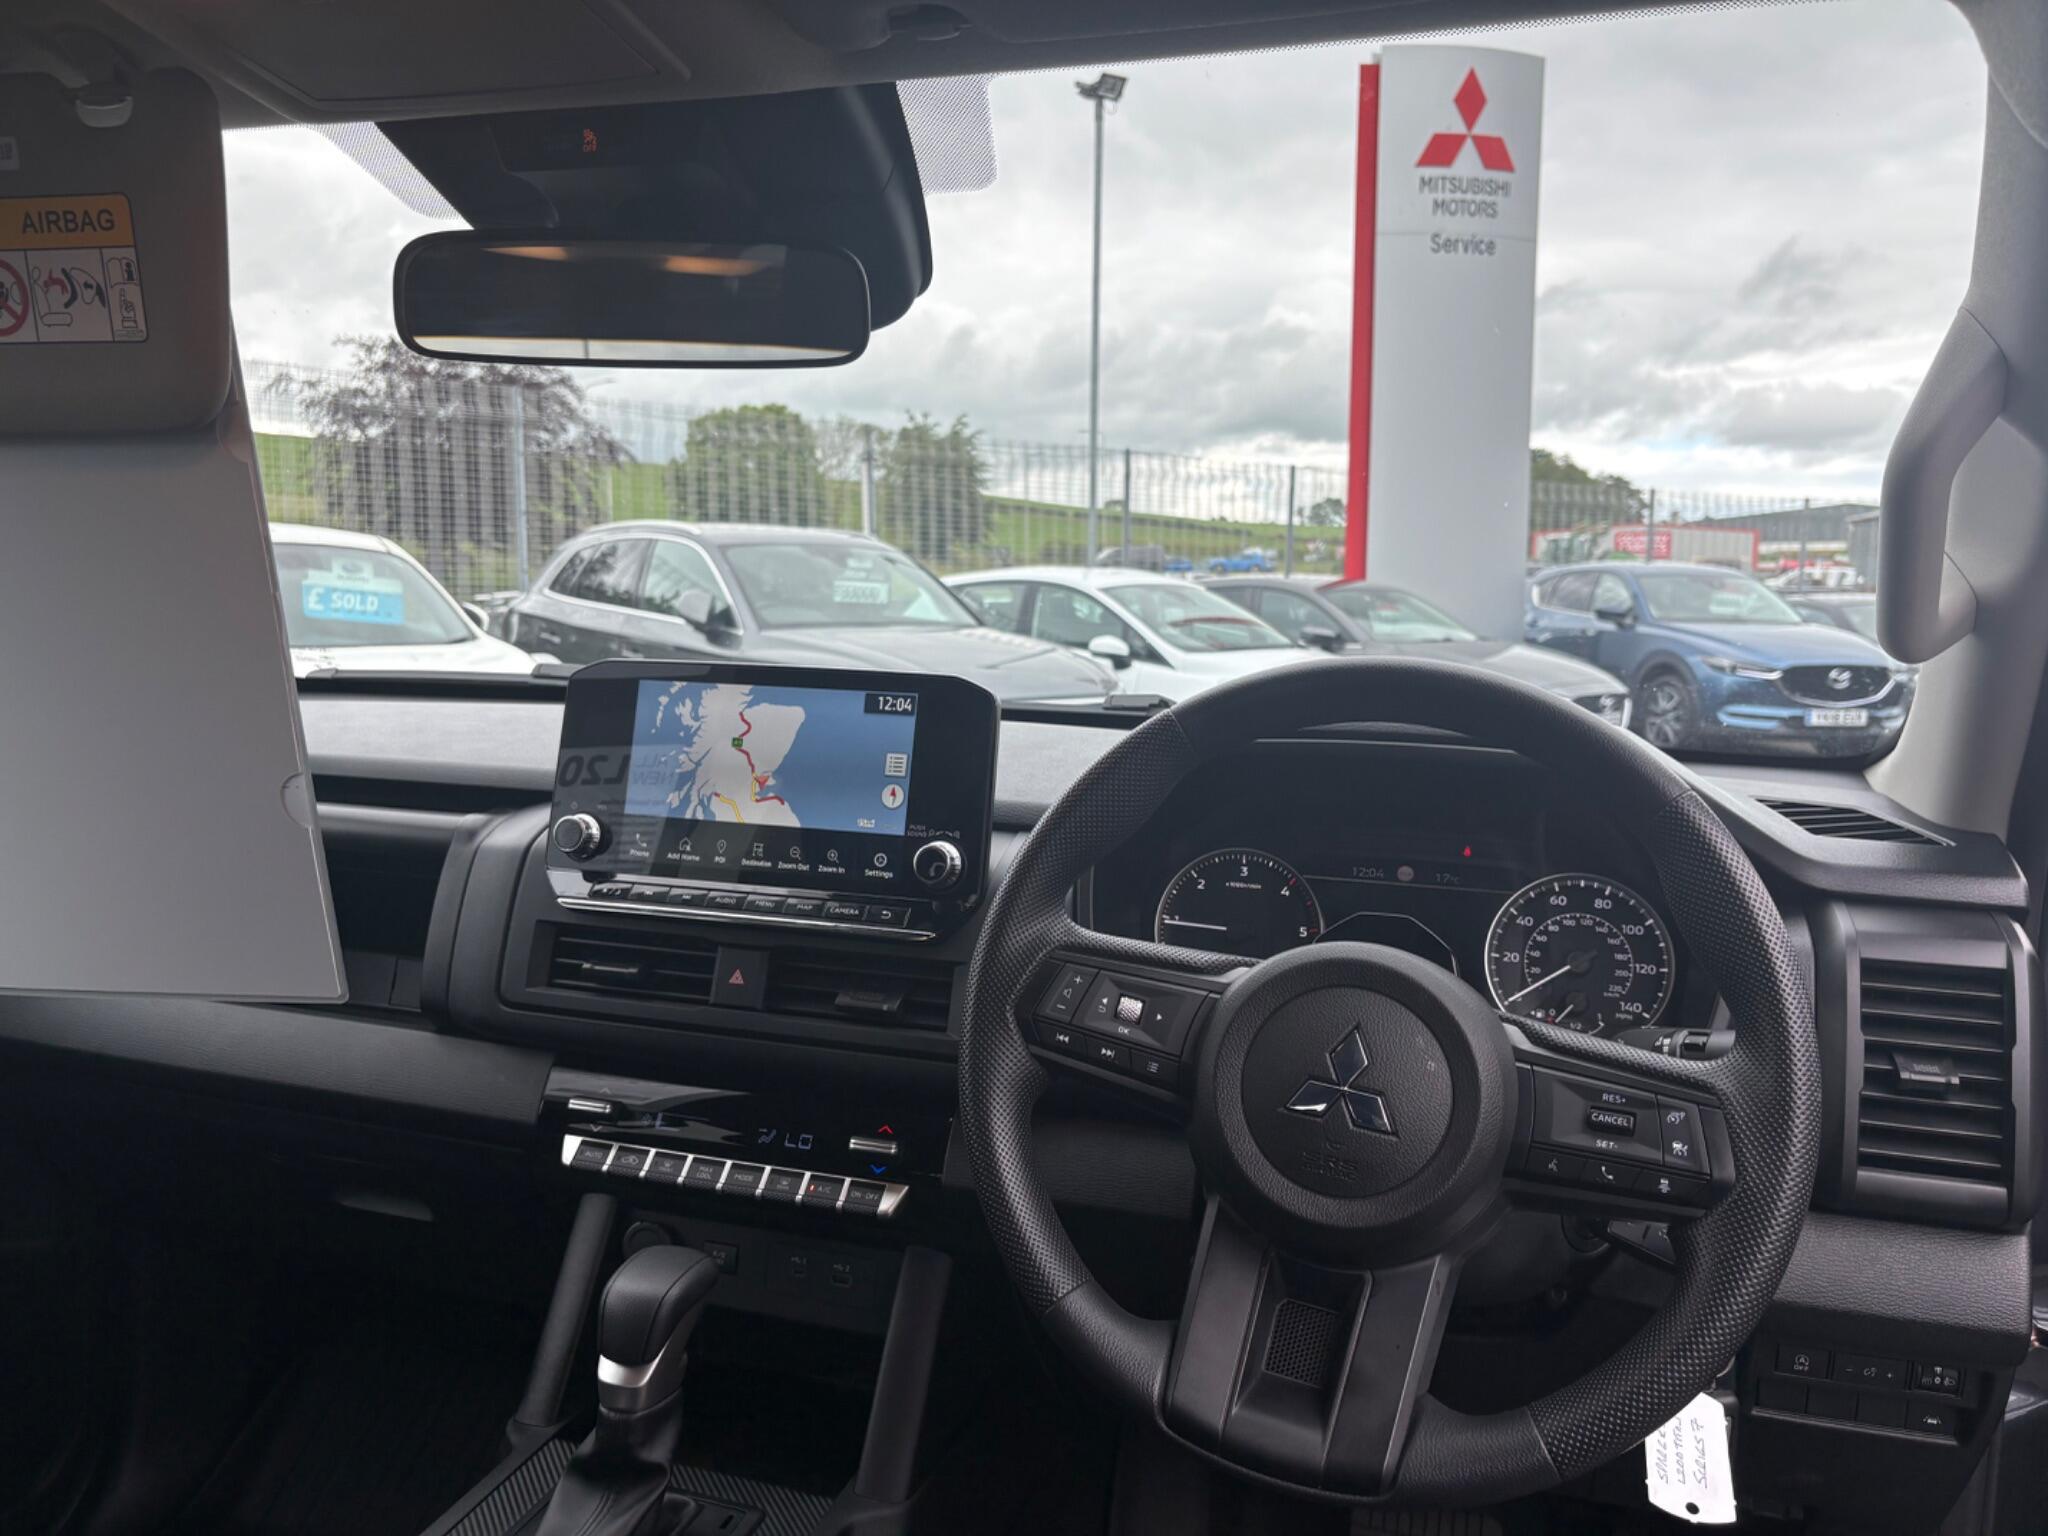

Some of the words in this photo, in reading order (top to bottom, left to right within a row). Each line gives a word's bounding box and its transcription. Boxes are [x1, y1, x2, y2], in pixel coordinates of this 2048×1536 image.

[1419, 176, 1511, 197] MITSUBISHI
[1432, 198, 1497, 218] MOTORS
[21, 208, 115, 235] AIRBAG
[1430, 233, 1496, 256] Service
[330, 592, 379, 612] SOLD
[877, 696, 913, 712] 12:04
[666, 852, 681, 860] Add
[682, 854, 700, 862] Home
[714, 856, 726, 864] POI
[778, 861, 797, 870] Zoom
[797, 863, 810, 871] Out
[818, 864, 836, 873] Zoom
[1239, 866, 1248, 877] 3
[864, 868, 893, 879] Settings
[1352, 866, 1384, 879] 12:04
[1196, 879, 1206, 890] 2
[1280, 886, 1290, 897] 4
[715, 897, 736, 905] AUDIO
[755, 900, 775, 908] MENU
[1550, 896, 1567, 906] 60
[1594, 899, 1612, 910] 80
[829, 907, 859, 916] CAMERA
[1516, 916, 1533, 927] 40
[1299, 927, 1308, 938] 5
[1595, 925, 1609, 934] 140
[1622, 924, 1644, 936] 100
[1607, 938, 1621, 946] 160
[1502, 952, 1520, 963] 20
[1614, 953, 1628, 961] 180
[1635, 963, 1656, 975] 120
[1608, 984, 1622, 992] 220
[1620, 1002, 1642, 1013] 140
[1118, 1026, 1130, 1035] OK
[1602, 1093, 1627, 1104] RES+
[1591, 1112, 1629, 1127] CANCEL
[584, 1150, 603, 1160] AUTO
[734, 1173, 754, 1182] MODE
[817, 1185, 832, 1194] A/C
[850, 1191, 862, 1199] ON
[865, 1192, 880, 1201] OFF
[1690, 1417, 1704, 1432] 7
[1692, 1435, 1708, 1489] SERIES
